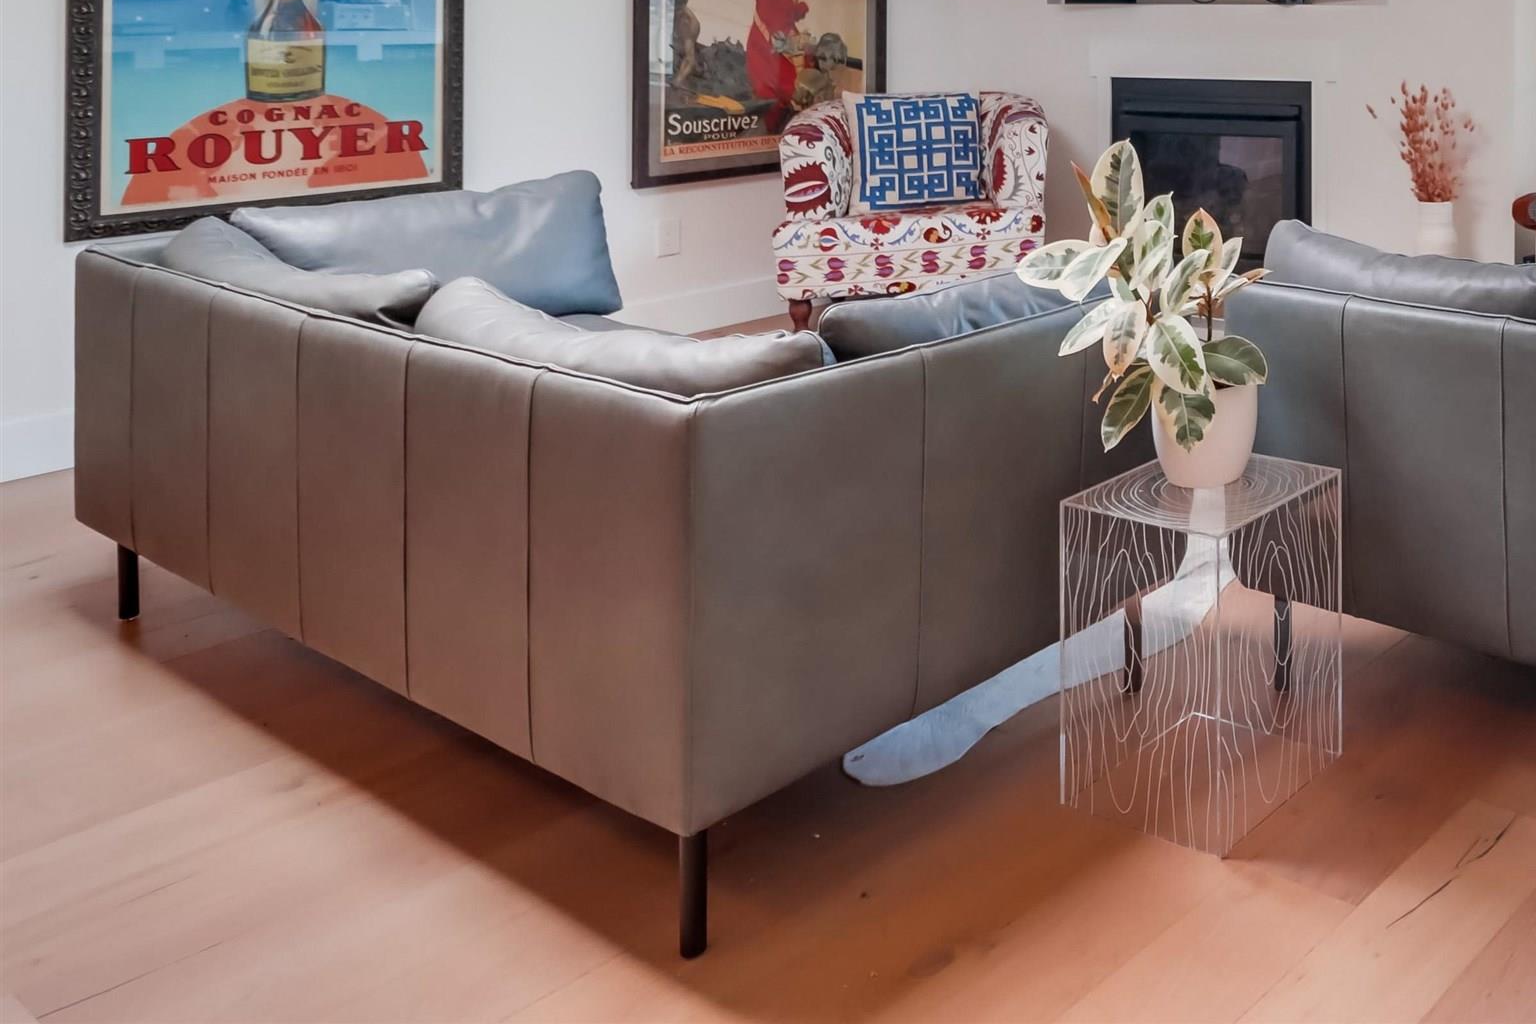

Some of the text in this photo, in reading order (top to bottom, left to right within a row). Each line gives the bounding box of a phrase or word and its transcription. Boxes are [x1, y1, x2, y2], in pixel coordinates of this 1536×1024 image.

[209, 103, 361, 126] COGNAC
[668, 114, 759, 135] Souscrivez
[703, 131, 737, 141] POUR
[124, 120, 429, 175] ROUYER
[207, 172, 257, 184] MAISON
[262, 167, 308, 179] FONDÉE
